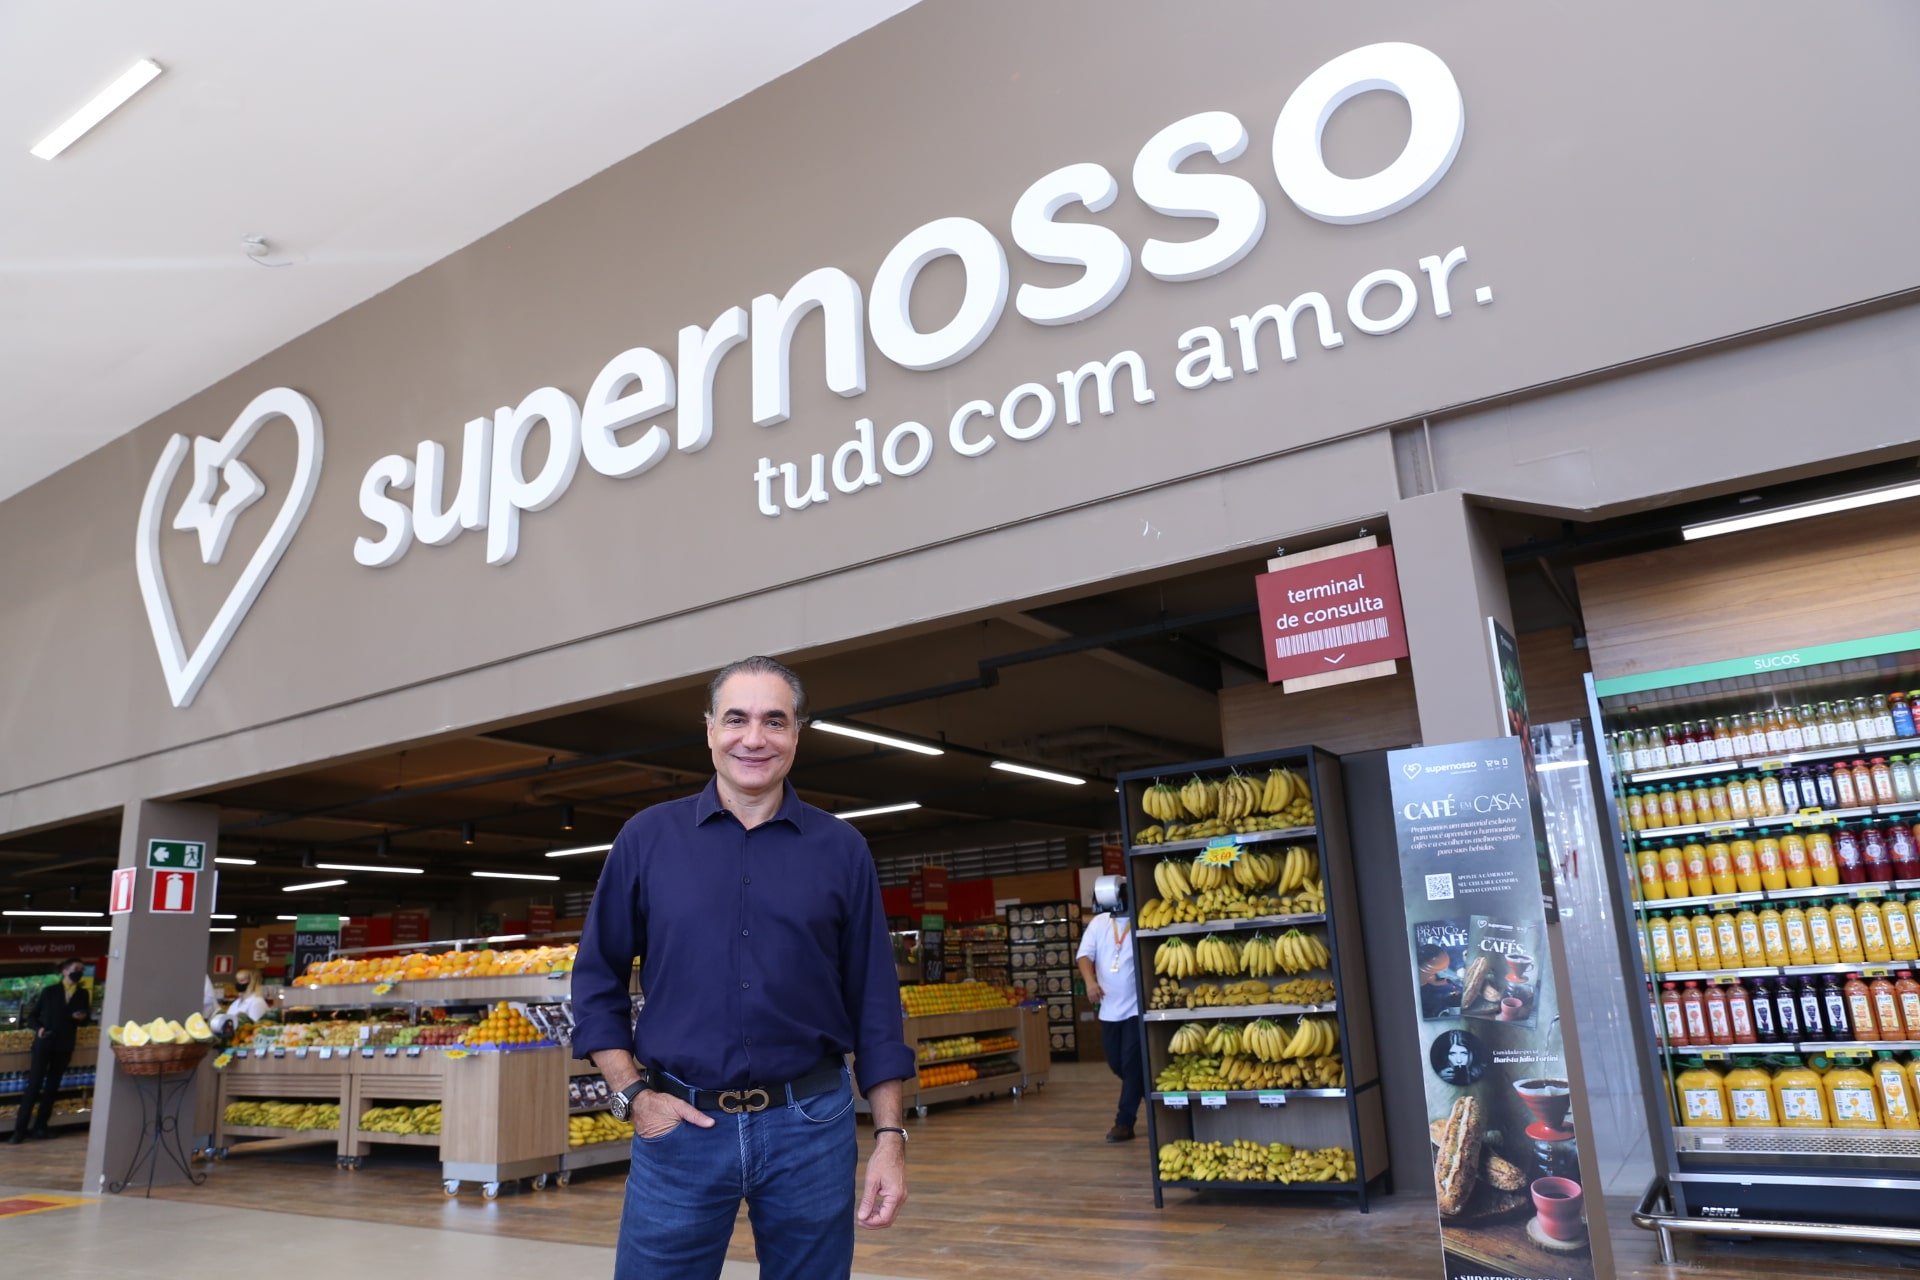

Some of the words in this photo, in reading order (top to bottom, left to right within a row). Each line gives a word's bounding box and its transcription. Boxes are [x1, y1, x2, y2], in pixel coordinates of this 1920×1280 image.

[354, 42, 1465, 565] supernosso
[754, 418, 933, 516] tudo
[949, 349, 1155, 456] com
[1176, 246, 1494, 388] amor.
[1287, 574, 1365, 604] terminal
[1276, 613, 1299, 630] de
[1303, 597, 1384, 624] consulta
[1753, 653, 1800, 670] SUCOS
[1424, 761, 1477, 774] supernosso
[1403, 793, 1458, 821] CAFÉ
[1473, 792, 1522, 813] CASA
[18, 944, 47, 953] viver
[49, 943, 76, 953] bem
[1701, 1206, 1740, 1217] PERFIL
